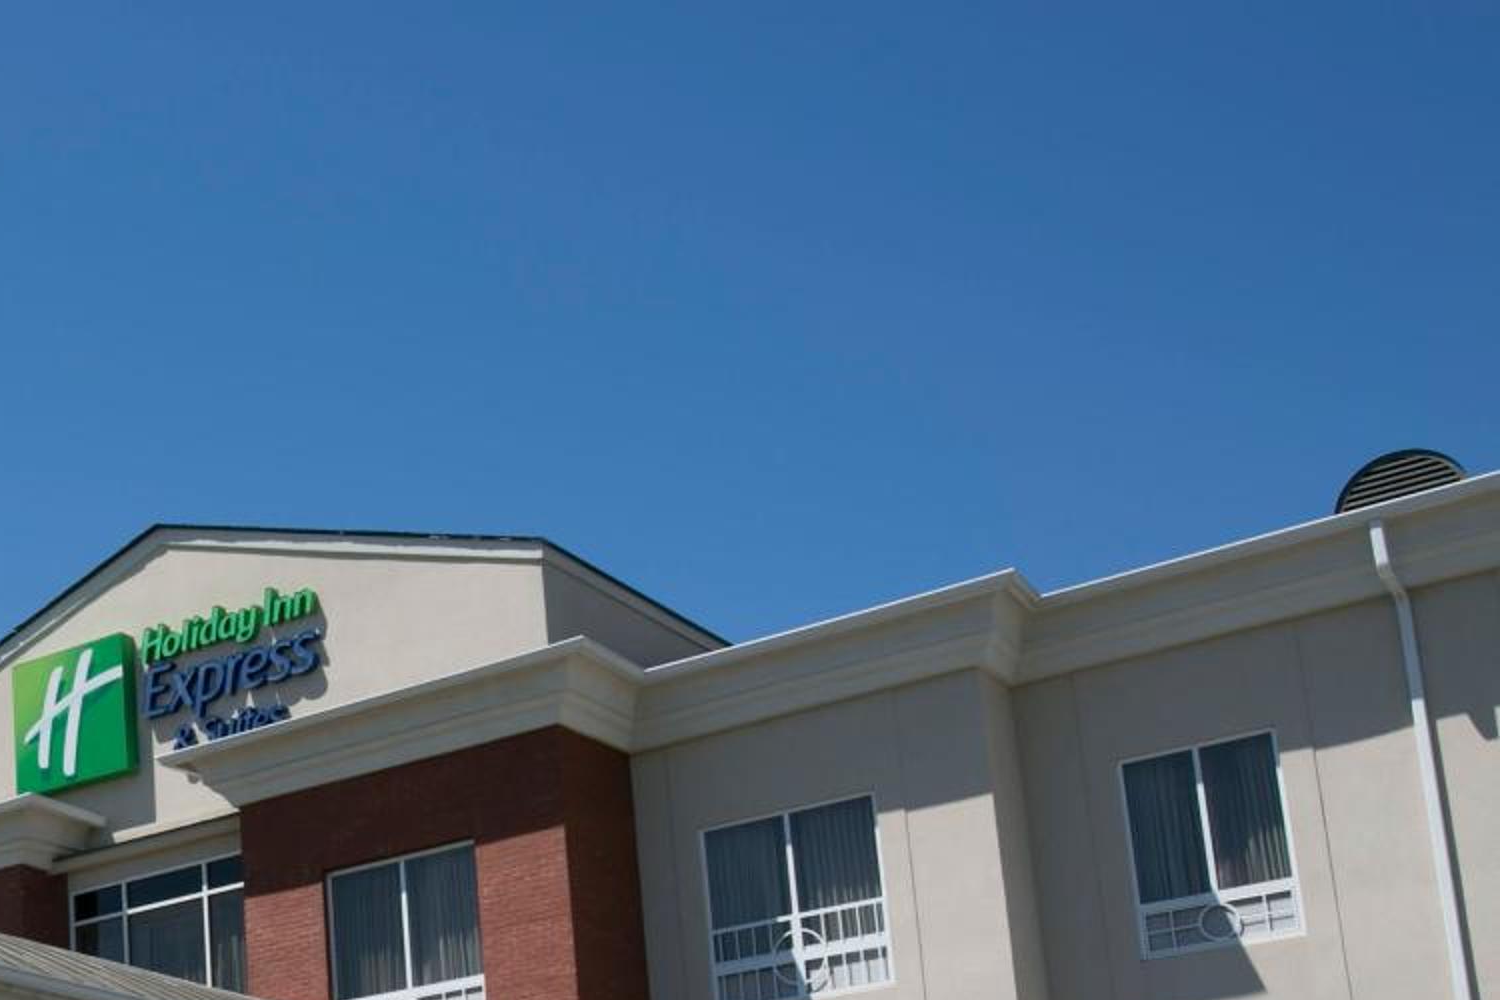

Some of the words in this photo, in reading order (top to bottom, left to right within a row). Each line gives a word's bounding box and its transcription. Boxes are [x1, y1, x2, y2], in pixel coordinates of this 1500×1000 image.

[140, 605, 262, 665] Holiday
[263, 587, 319, 626] Inn
[143, 631, 323, 720] Express
